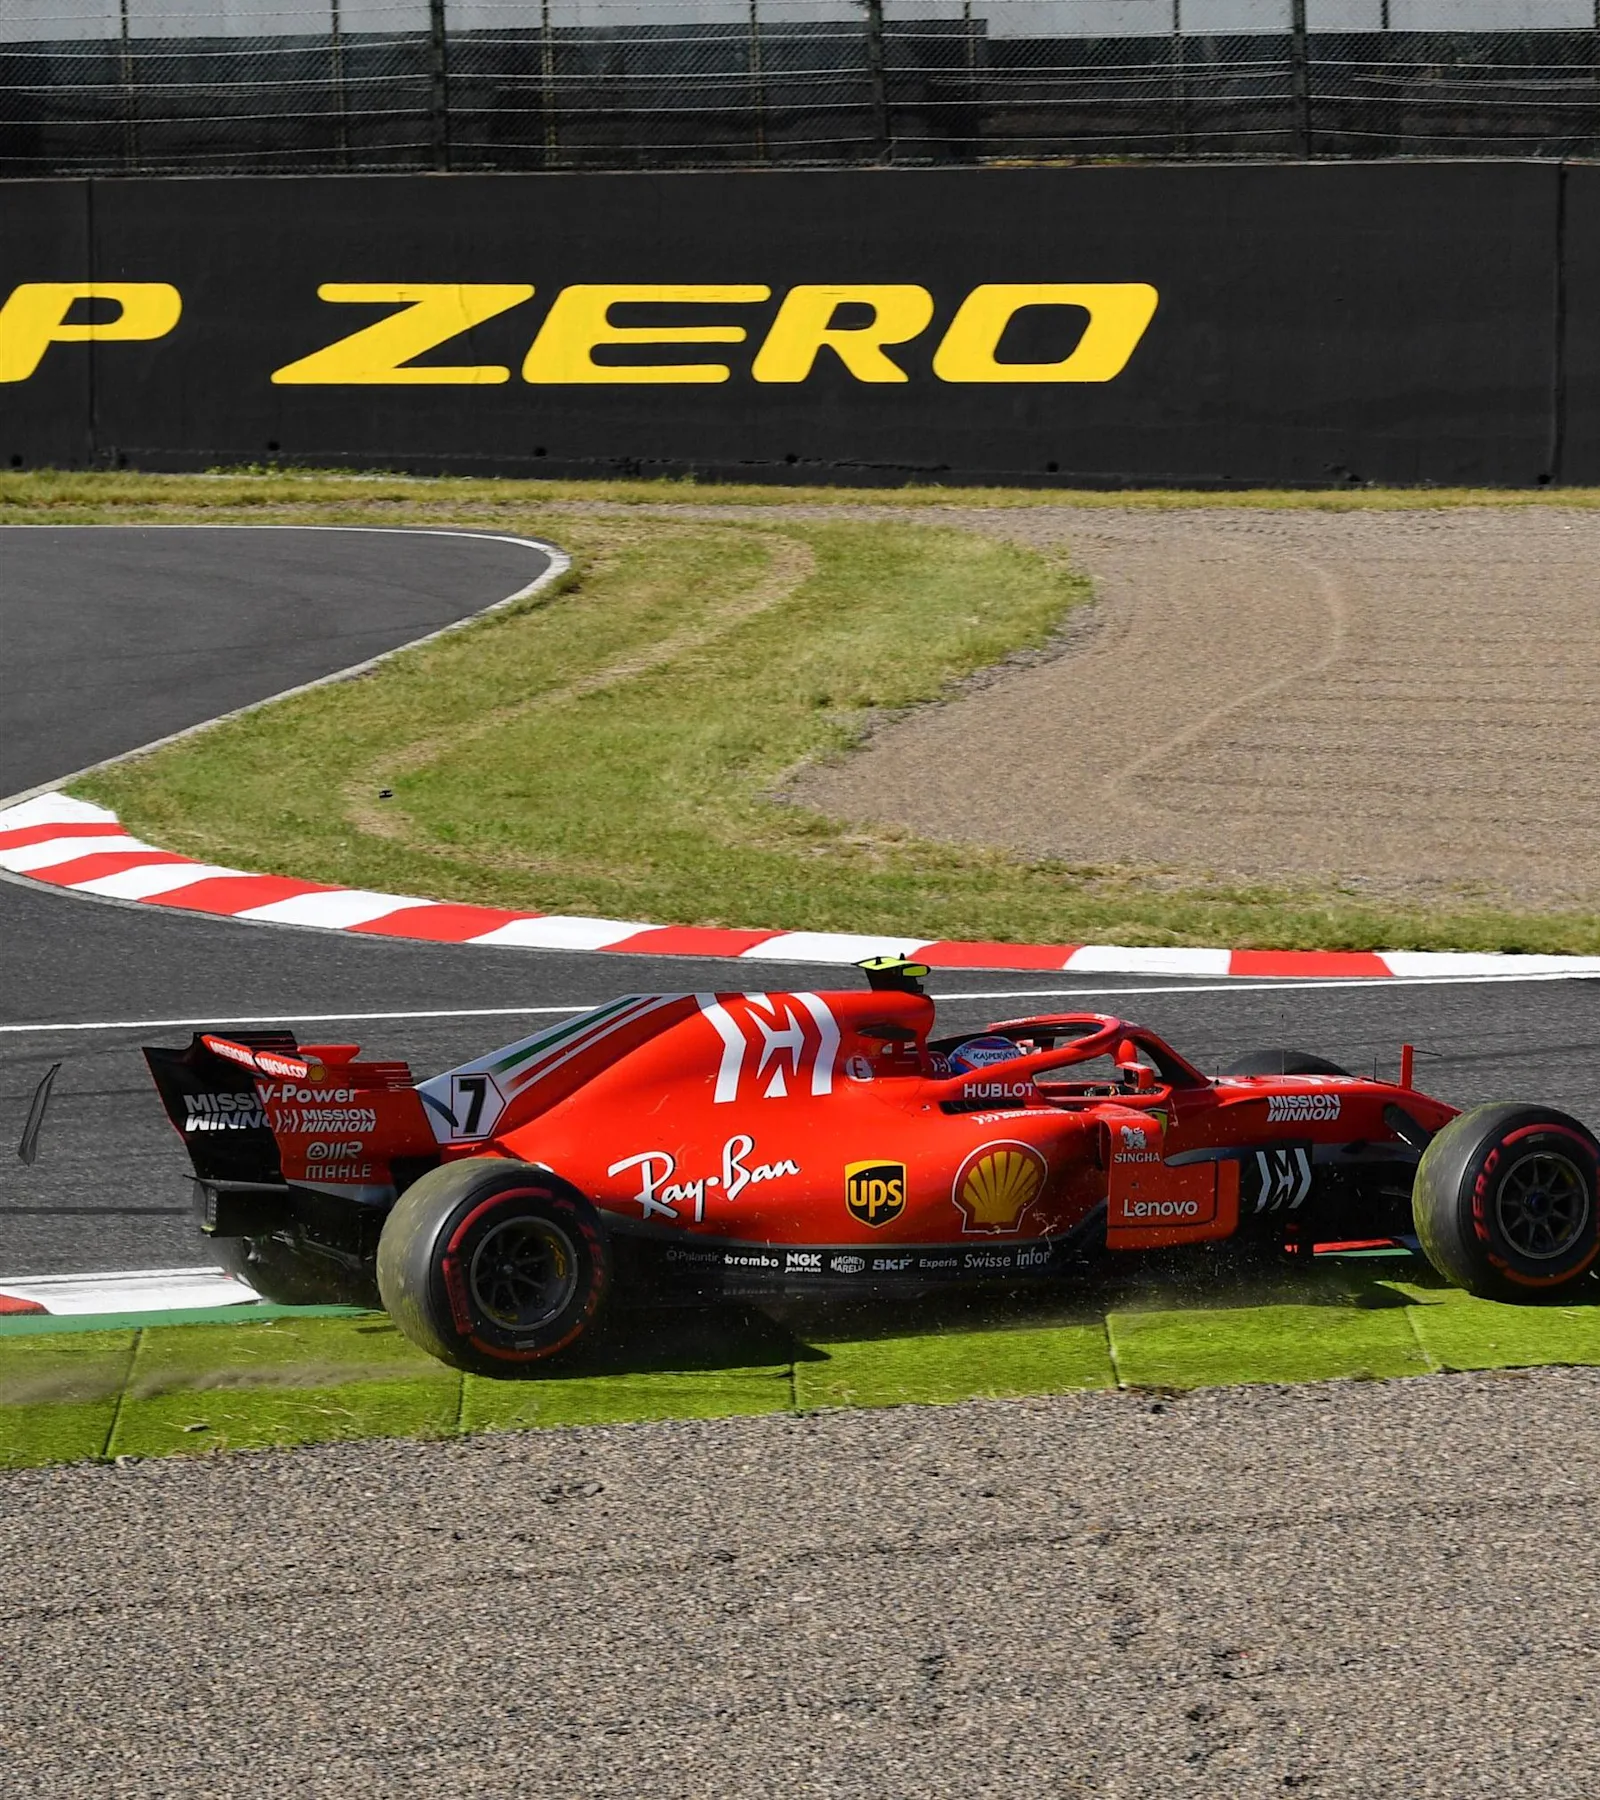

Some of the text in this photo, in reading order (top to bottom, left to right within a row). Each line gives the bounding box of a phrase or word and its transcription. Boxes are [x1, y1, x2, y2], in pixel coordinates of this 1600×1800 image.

[0, 282, 1160, 384] P ZERO
[258, 1084, 356, 1104] V-Power
[964, 1083, 1034, 1098] HUBLOT
[183, 1092, 264, 1113] MISSI
[459, 1076, 488, 1135] 7
[1267, 1094, 1341, 1108] MISSION
[302, 1109, 376, 1121] MISSION
[1266, 1107, 1340, 1122] WINNOW
[301, 1120, 376, 1132] WINNOW
[1114, 1152, 1160, 1164] SINGHA
[305, 1164, 372, 1178] MAHLE
[850, 1177, 904, 1215] ups
[1124, 1199, 1198, 1216] Lenovo
[724, 1254, 779, 1267] brembo
[786, 1253, 822, 1266] NGK
[872, 1258, 914, 1270] SKF
[919, 1258, 958, 1268] Experis
[964, 1253, 1011, 1268] Swisse
